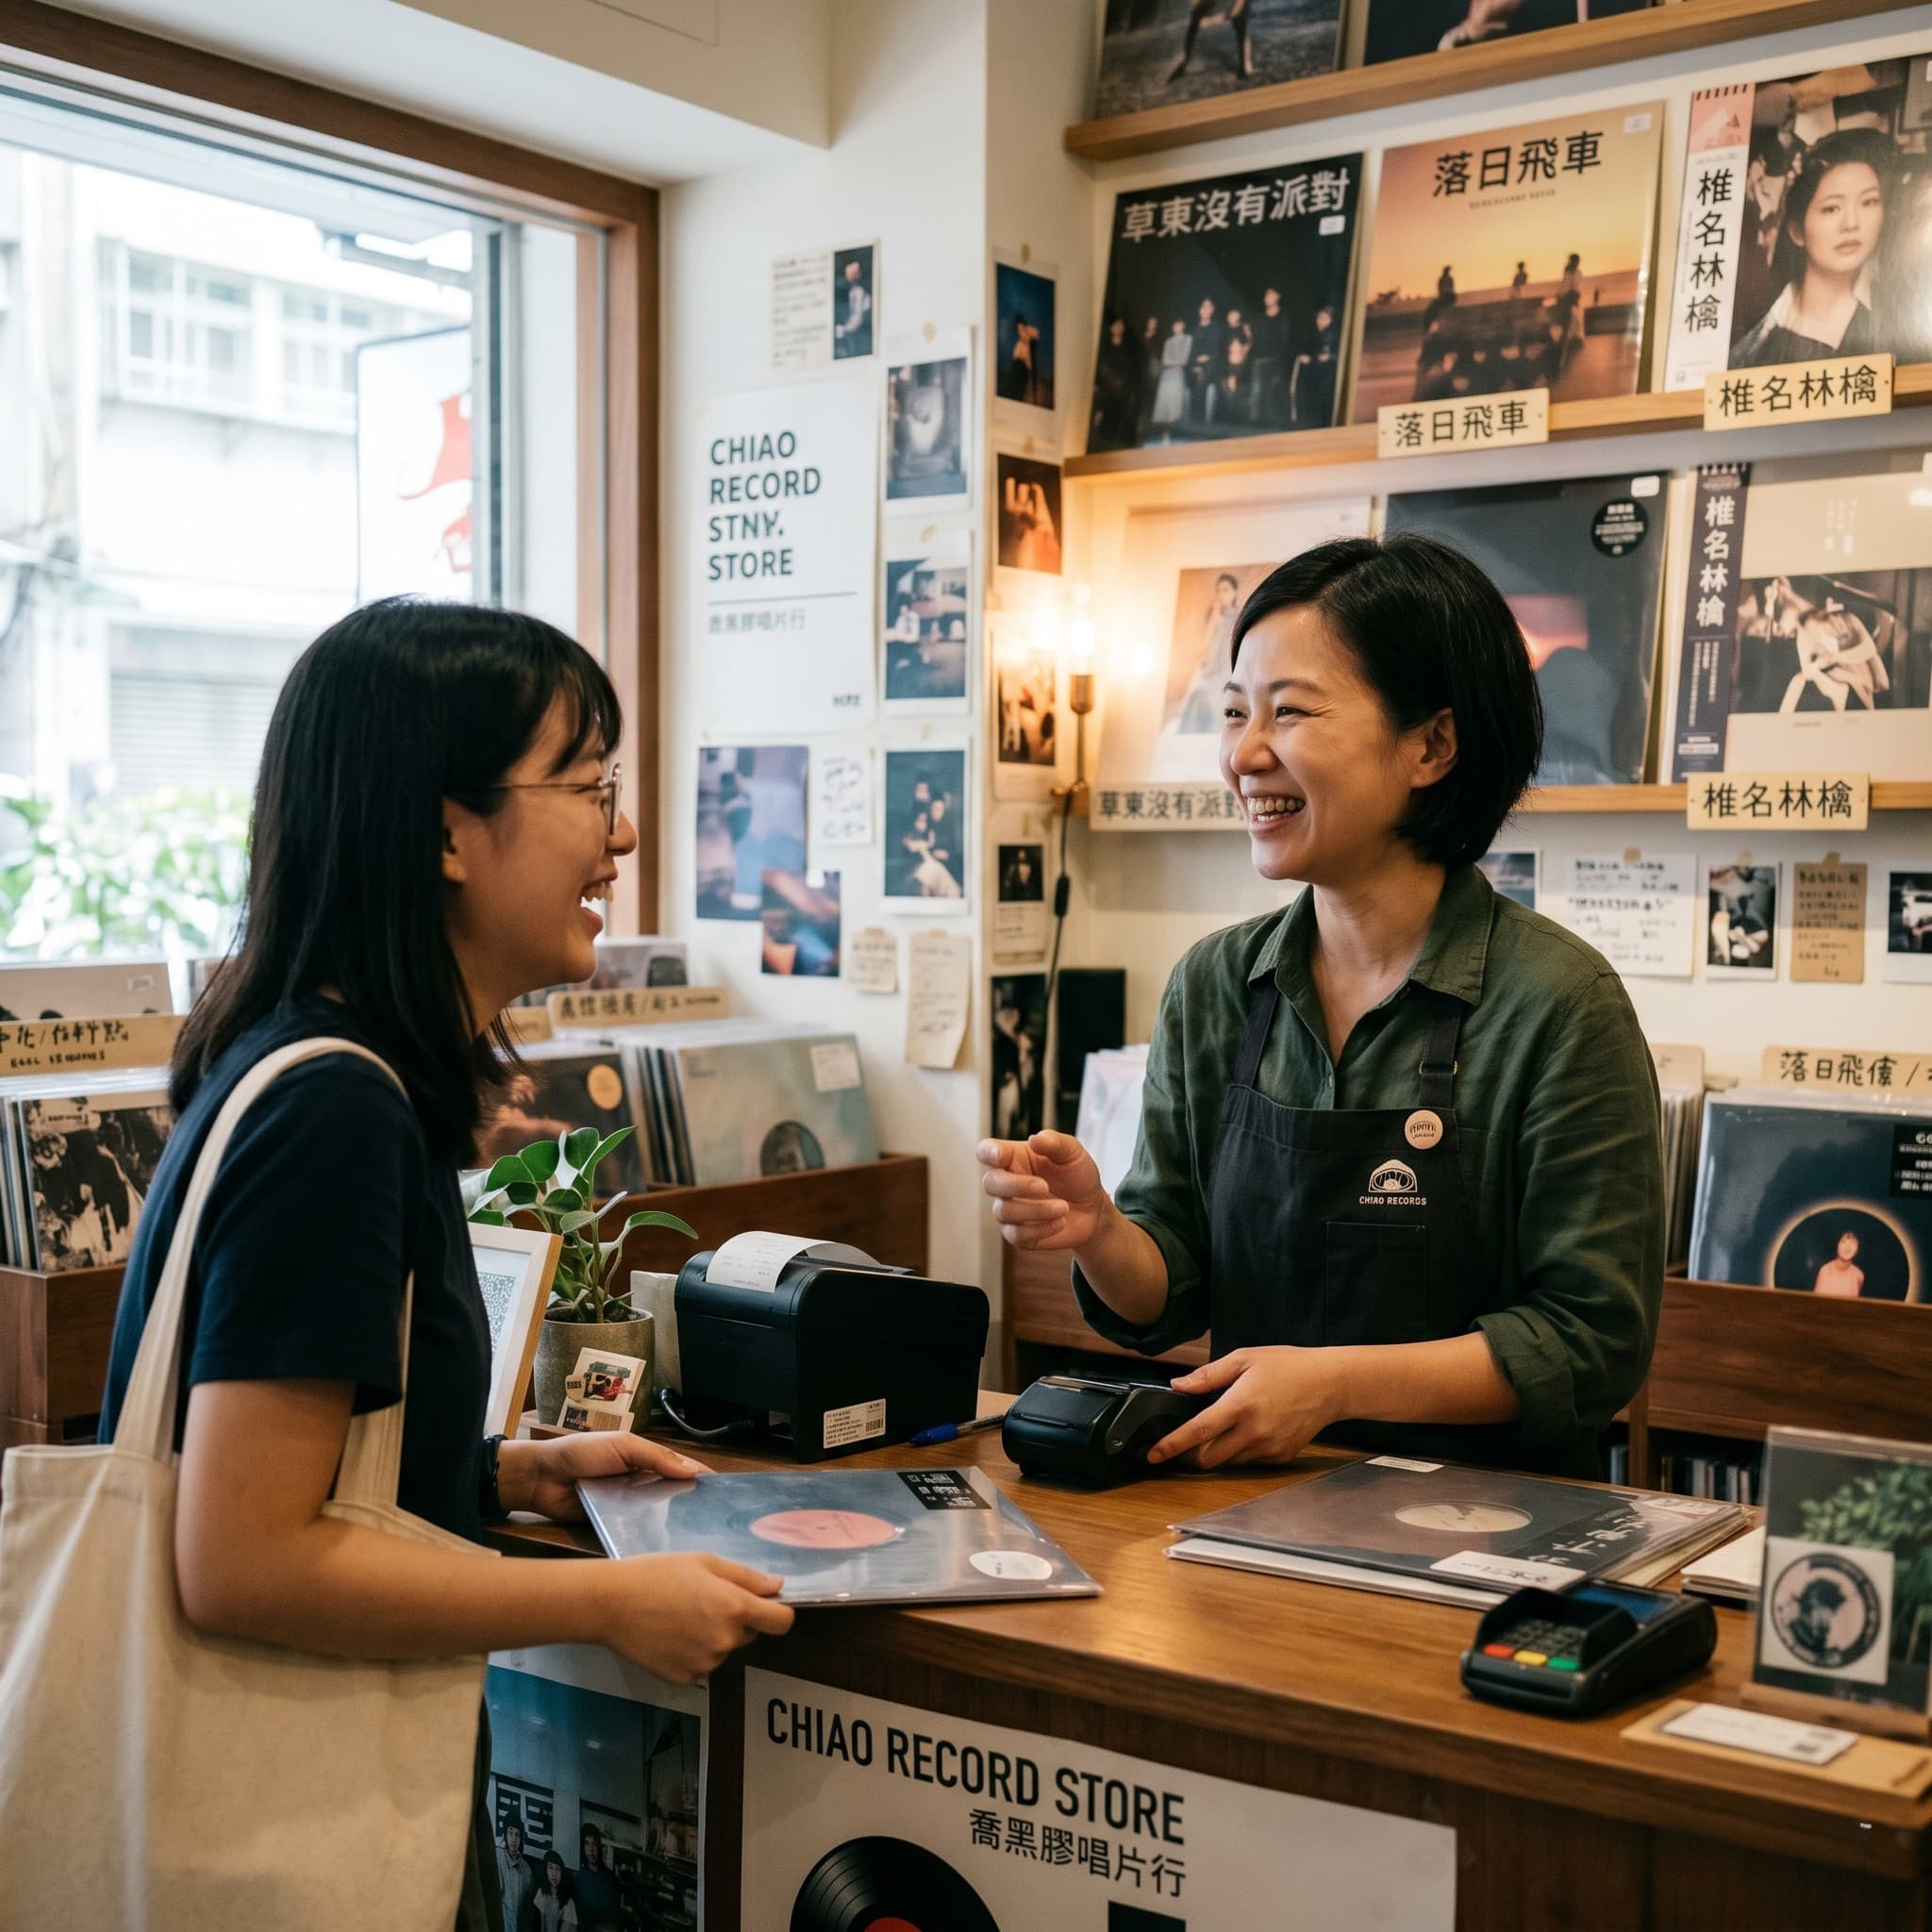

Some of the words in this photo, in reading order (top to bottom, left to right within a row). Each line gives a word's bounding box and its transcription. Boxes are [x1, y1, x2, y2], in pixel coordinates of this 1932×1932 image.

[1433, 131, 1604, 197] 落日飛車
[1122, 167, 1350, 242] 草東沒有派對
[1684, 168, 1734, 333] 椎名林檎
[1719, 364, 1877, 418] 椎名林檎
[710, 431, 796, 466] CHIAO
[1395, 400, 1528, 448] 落日飛車
[709, 468, 822, 505] RECORD
[708, 549, 793, 581] STORE
[1703, 779, 1854, 820] 椎名林檎
[1358, 1195, 1385, 1205] CHIAO
[767, 1698, 873, 1767] CHIAO
[887, 1726, 1040, 1807] RECORD
[1055, 1767, 1185, 1845] STORE
[970, 1808, 1187, 1898] 喬黑膠唱片行
